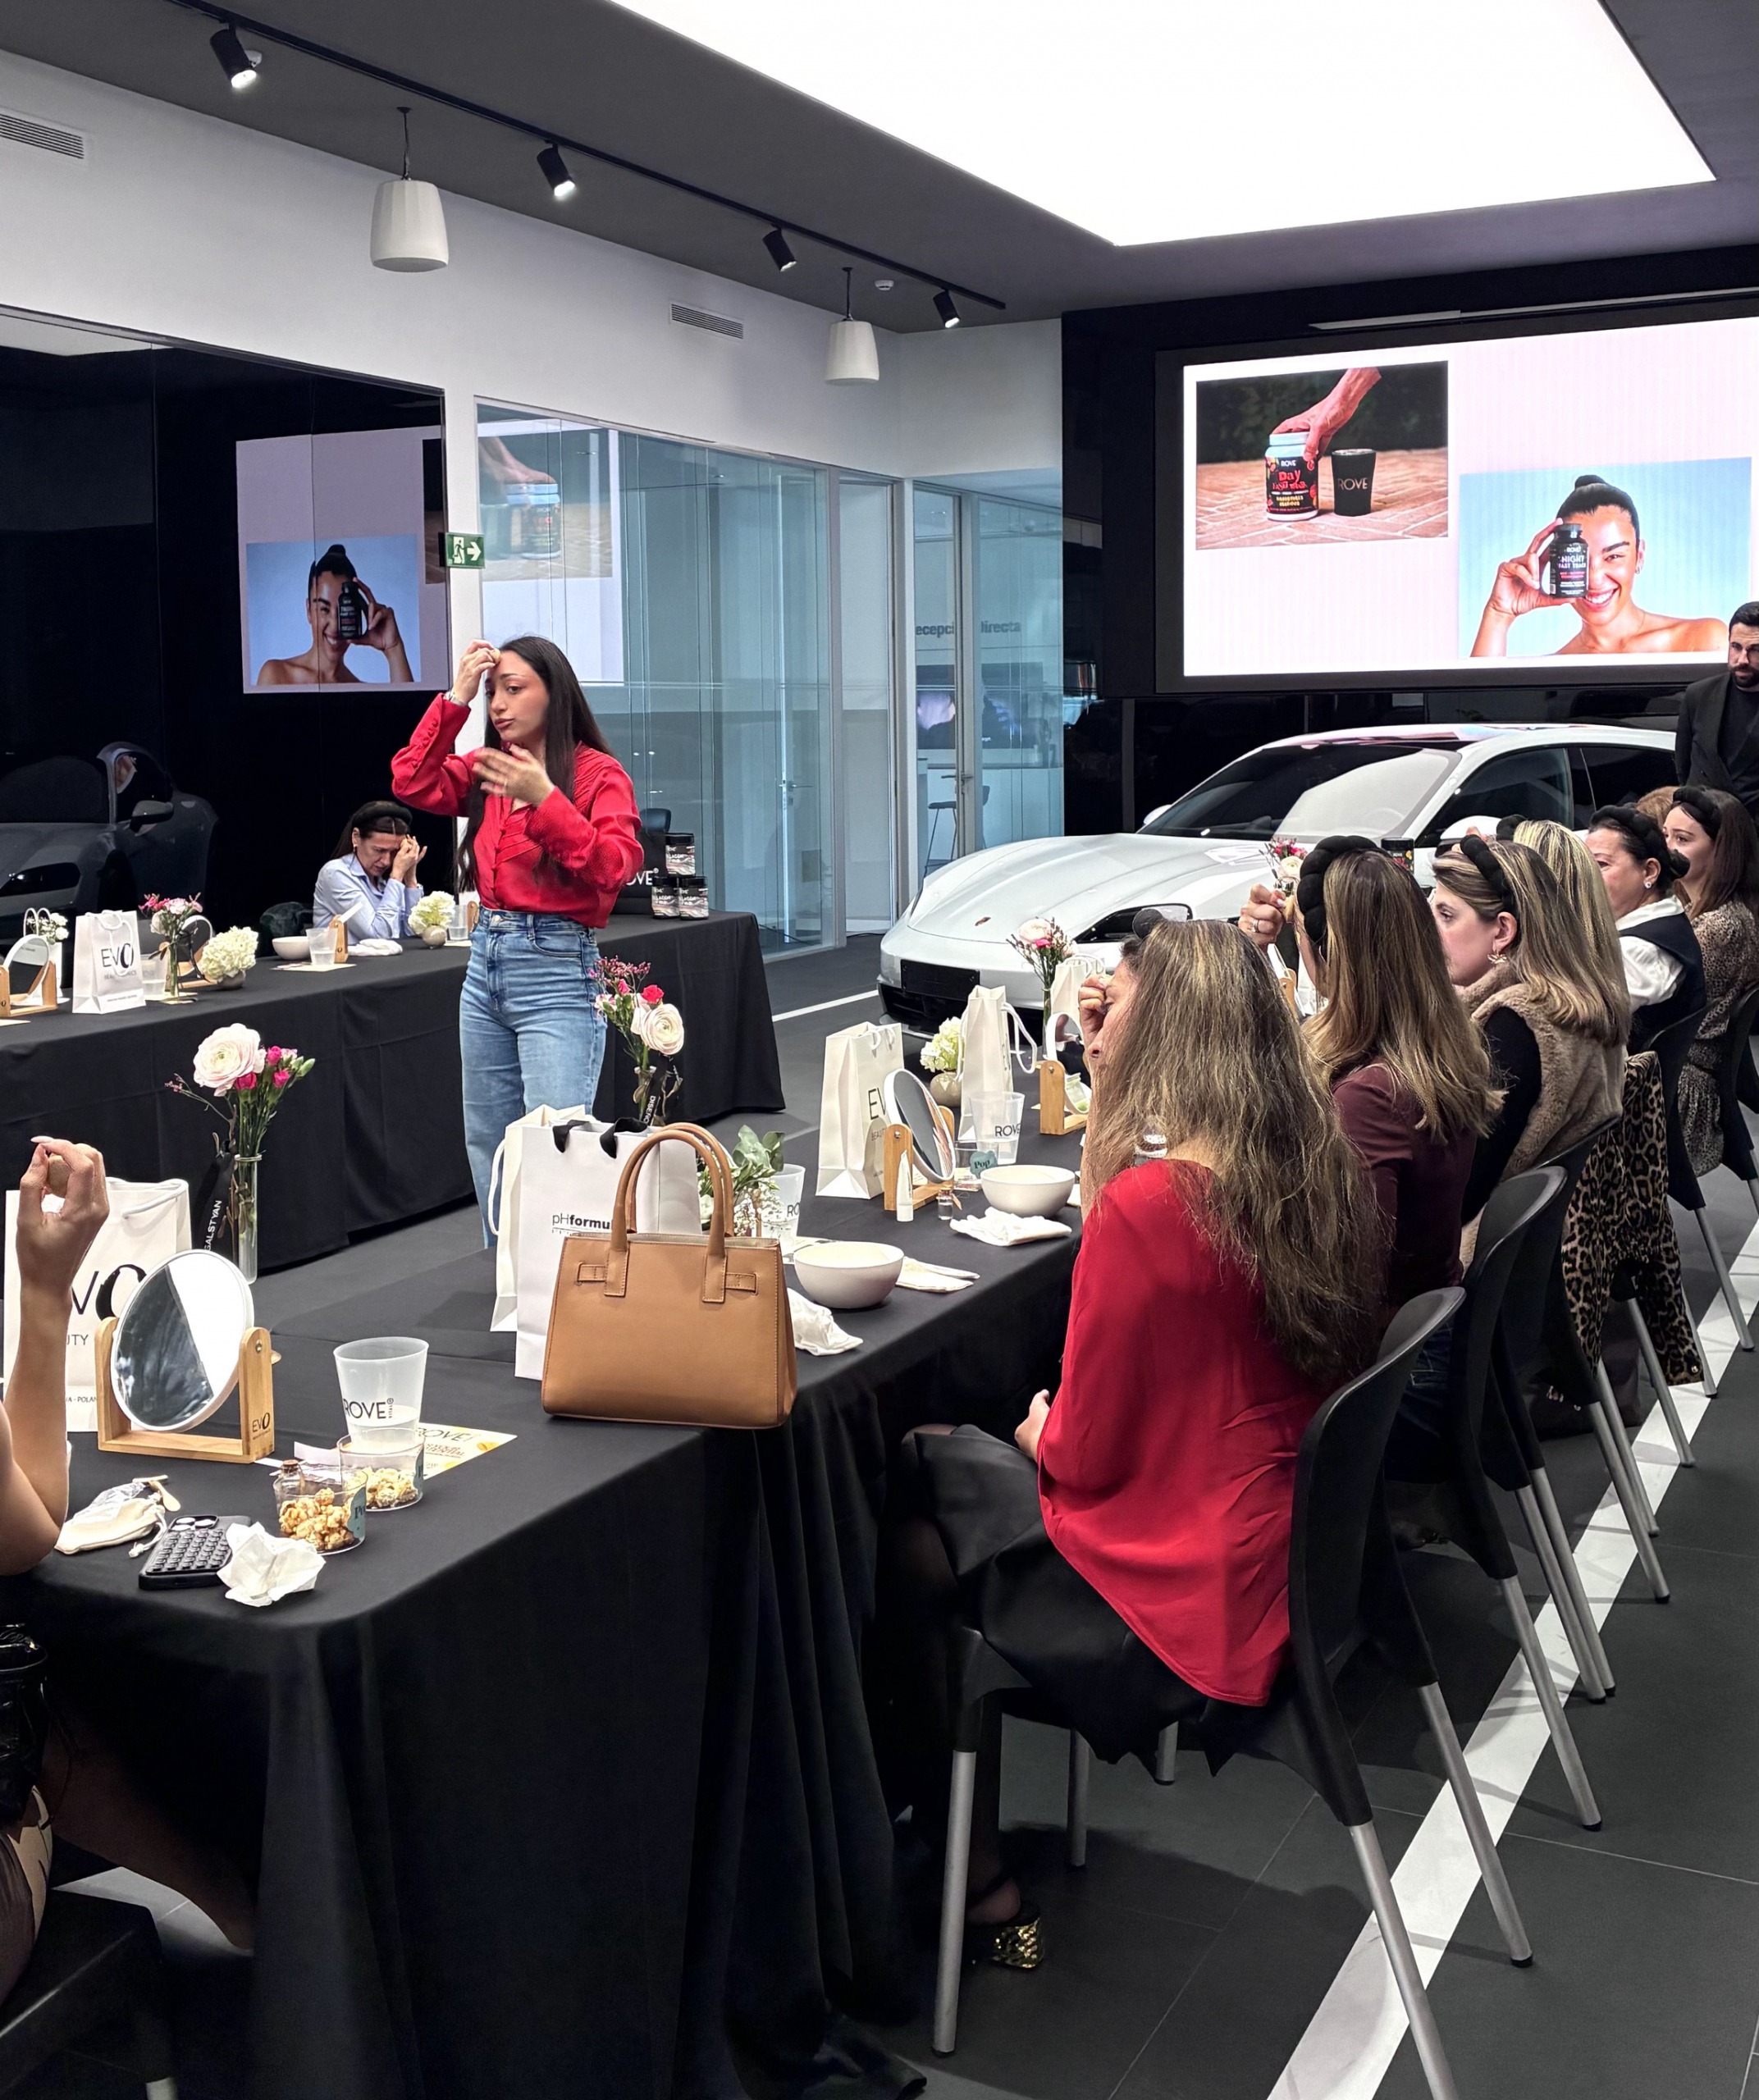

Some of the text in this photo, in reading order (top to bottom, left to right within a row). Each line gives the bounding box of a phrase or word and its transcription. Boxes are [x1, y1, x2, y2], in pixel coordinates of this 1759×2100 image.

[1337, 477, 1368, 491] ROVE
[915, 622, 954, 638] ecepci
[101, 943, 134, 968] EVO
[868, 1088, 886, 1121] EV
[974, 1159, 990, 1170] Pop
[552, 1212, 613, 1230] pHformu
[252, 1412, 271, 1433] EVO
